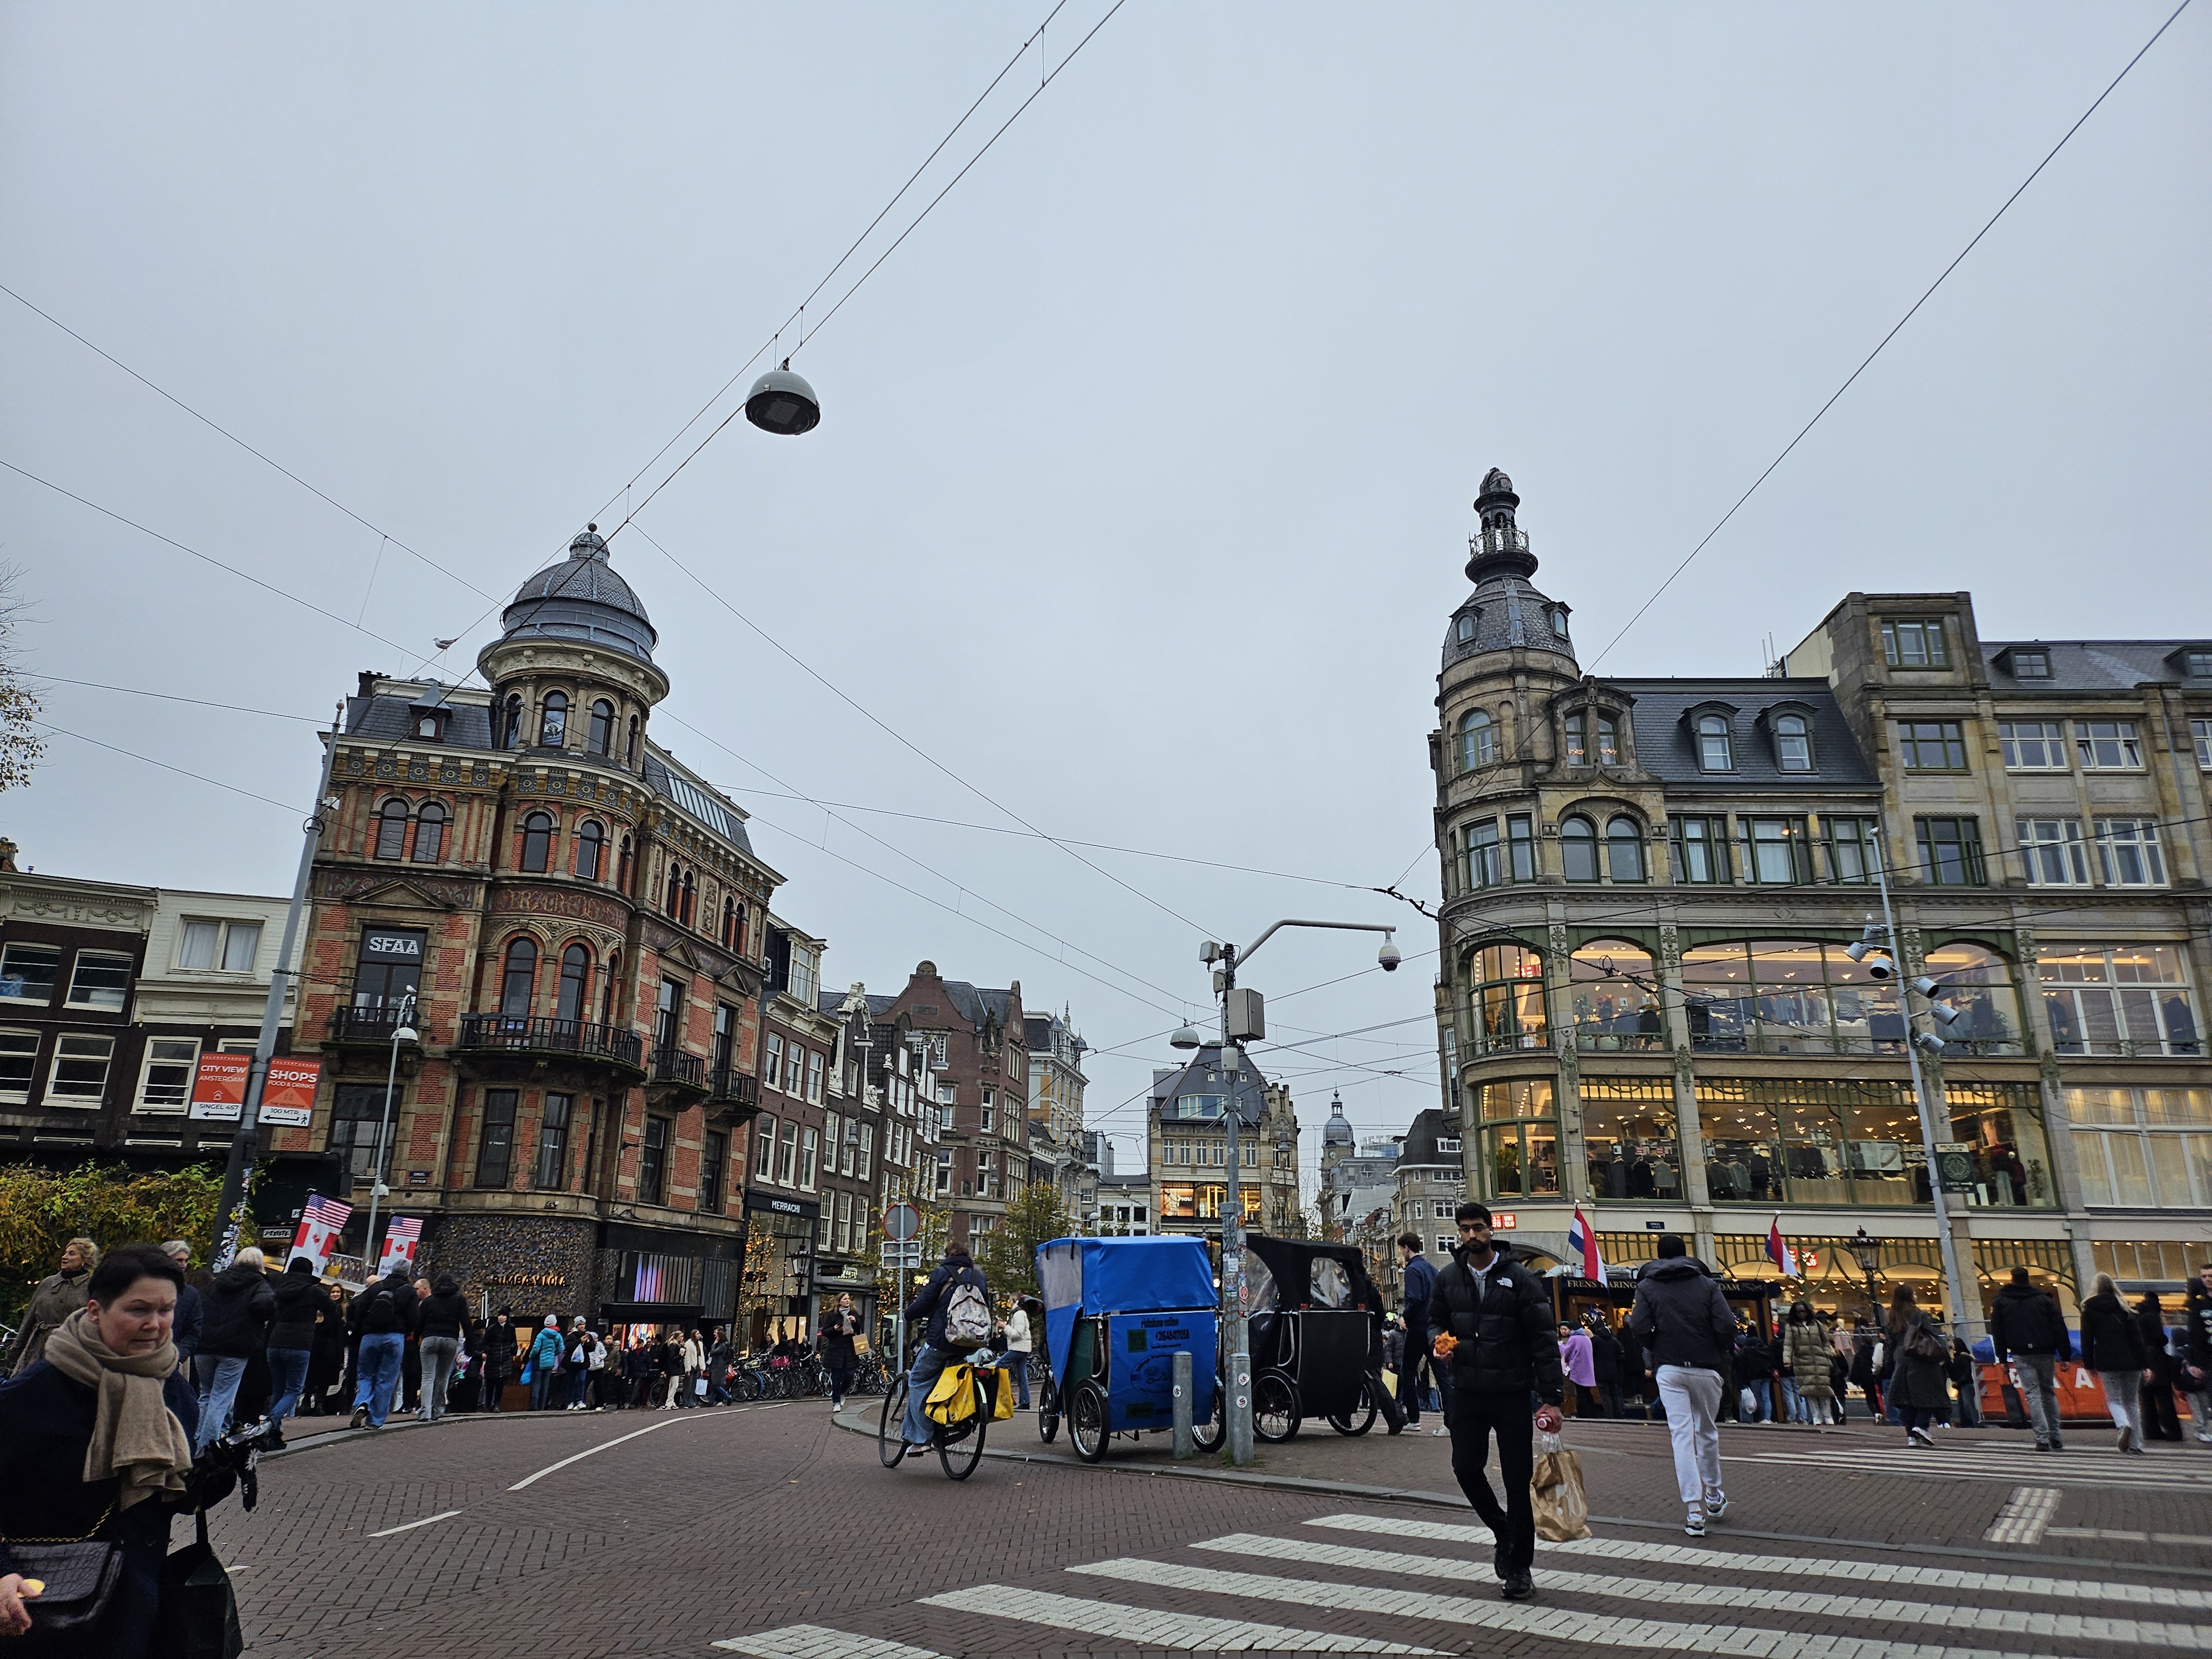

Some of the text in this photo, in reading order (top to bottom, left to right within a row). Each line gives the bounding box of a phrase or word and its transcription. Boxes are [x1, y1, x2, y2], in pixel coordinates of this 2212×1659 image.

[369, 937, 419, 954] SFAA
[269, 1070, 317, 1083] SHOPS
[771, 1200, 800, 1213] MERRACHI
[1567, 1280, 1597, 1288] FRENS
